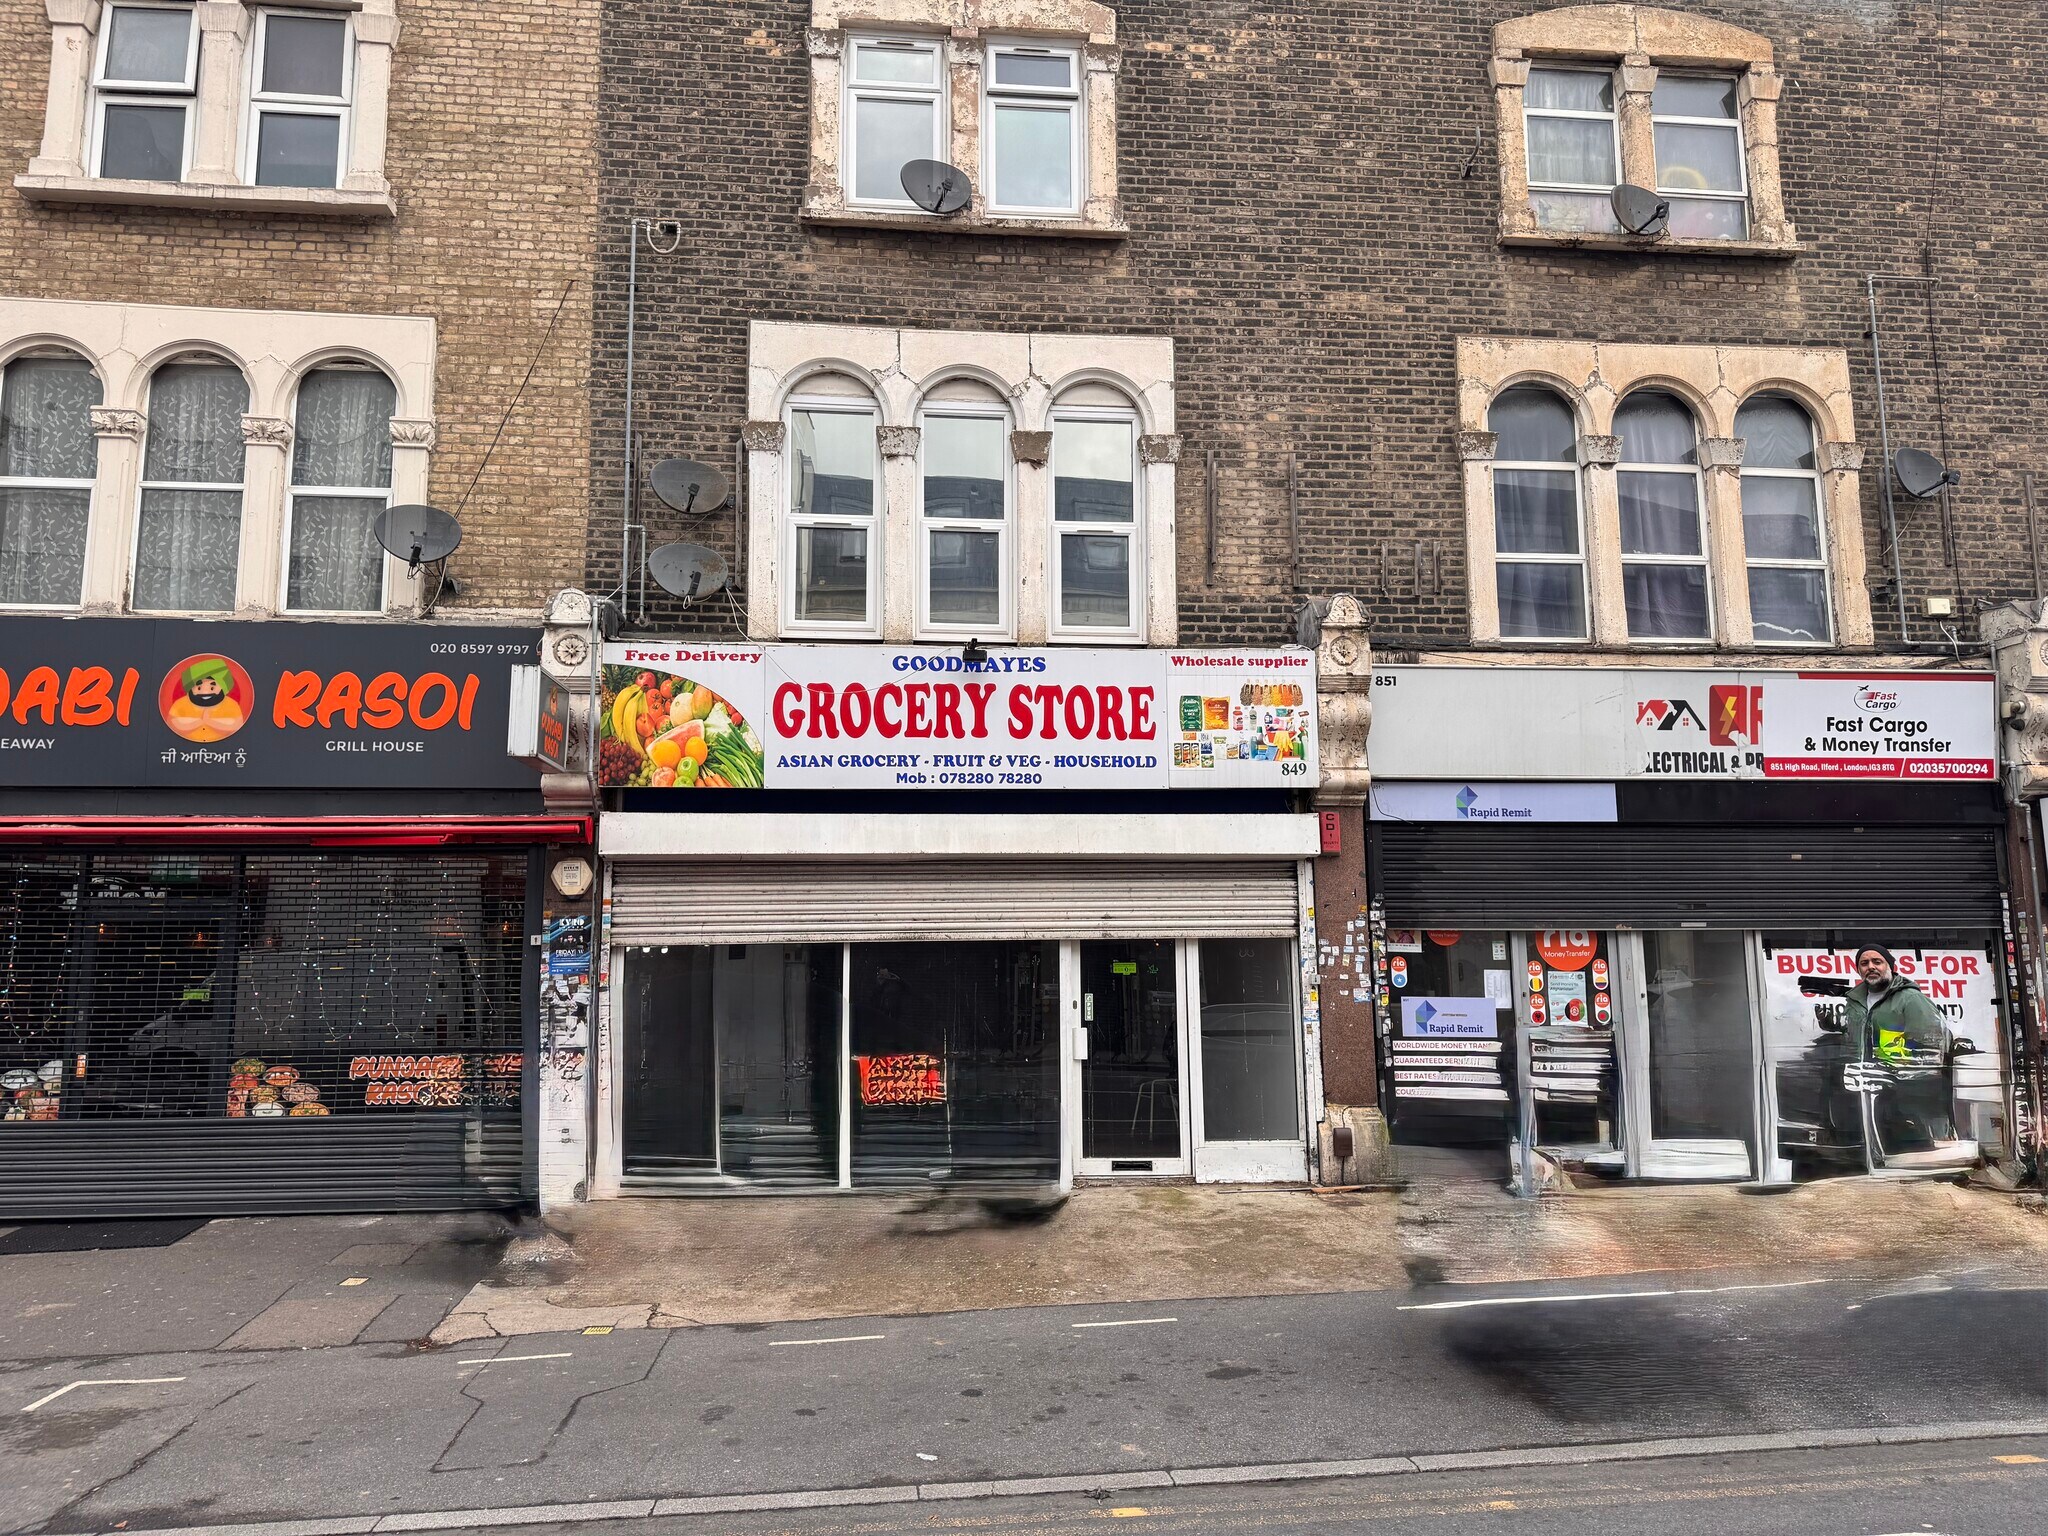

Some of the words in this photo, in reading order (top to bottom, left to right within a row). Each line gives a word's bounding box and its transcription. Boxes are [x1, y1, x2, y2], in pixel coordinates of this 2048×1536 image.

[430, 643, 457, 654] 020
[460, 643, 493, 654] 8597
[497, 644, 530, 655] 9797
[625, 650, 670, 661] Free
[676, 650, 763, 663] Delivery
[1171, 655, 1244, 667] Wholesale
[1248, 655, 1308, 668] supplier
[892, 656, 1046, 673] GOODMAYES
[1375, 676, 1397, 686] 851
[272, 670, 480, 731] RASOI
[1874, 692, 1897, 700] Fast
[1865, 700, 1897, 710] Cargo
[772, 682, 997, 739] GROCERY
[1008, 684, 1157, 741] STORE
[1826, 717, 1863, 732] Fast
[1869, 717, 1928, 736] Cargo
[0, 738, 55, 749] EAWAY
[325, 741, 368, 752] GRILL
[372, 741, 424, 752] HOUSE
[1804, 738, 1816, 751] &
[1822, 737, 1879, 754] Money
[1884, 737, 1951, 752] Transfer
[160, 748, 176, 764] ਜੀ
[181, 748, 231, 764] ਆਇਆ
[776, 754, 834, 768] ASIAN
[837, 754, 920, 769] GROCERY
[933, 755, 985, 768] FRUIT
[989, 755, 1003, 768] &
[1008, 756, 1042, 769] VEG
[1054, 756, 1158, 769] HOUSEHOLD
[1645, 751, 1728, 773] LECTRICAL
[1281, 763, 1307, 776] 849
[1770, 763, 1784, 771] 851
[1785, 763, 1800, 772] High
[1801, 763, 1820, 772] Road,
[1821, 763, 1839, 771] Ilford
[1882, 763, 1895, 771] 8TG
[1909, 763, 1988, 774] 02035700294
[896, 773, 928, 784] Mob
[939, 773, 994, 784] 078280
[998, 773, 1042, 784] 78280
[1470, 807, 1500, 819] Rapid
[1501, 808, 1532, 817] Remit
[1392, 958, 1405, 967] ria
[1528, 963, 1541, 971] ria
[1594, 960, 1606, 969] ria
[1777, 955, 1916, 975] BUSINS
[1925, 956, 1980, 975] FOR
[1914, 979, 1967, 998] ENT
[1530, 996, 1543, 1004] ria
[1596, 995, 1609, 1003] ria
[1936, 1003, 1963, 1019] NT)
[1429, 1024, 1455, 1035] Rapid
[1457, 1024, 1484, 1033] Remit
